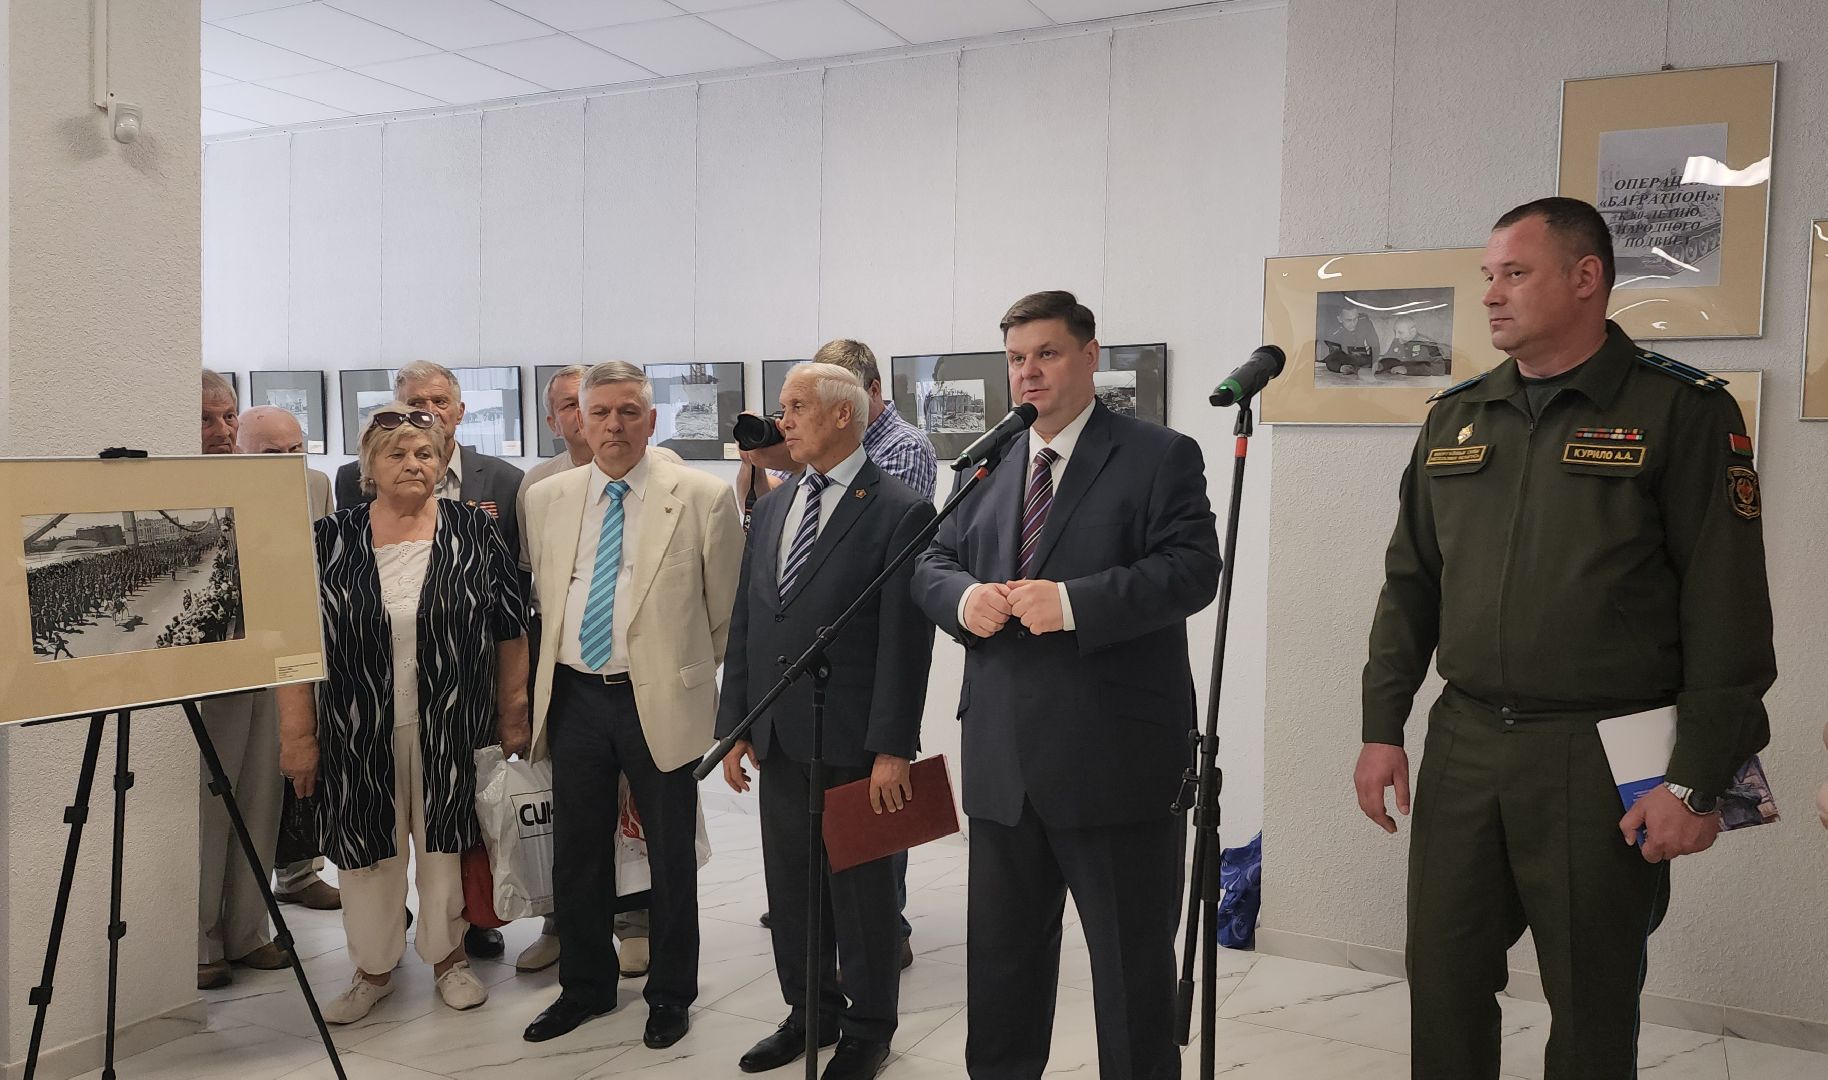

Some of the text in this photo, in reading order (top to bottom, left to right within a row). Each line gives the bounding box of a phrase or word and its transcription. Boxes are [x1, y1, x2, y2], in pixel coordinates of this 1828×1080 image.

[1614, 175, 1706, 191] ОПЕРАЦ
[1615, 221, 1700, 235] НАРОДНОГО
[1573, 448, 1613, 459] КУРИЛО
